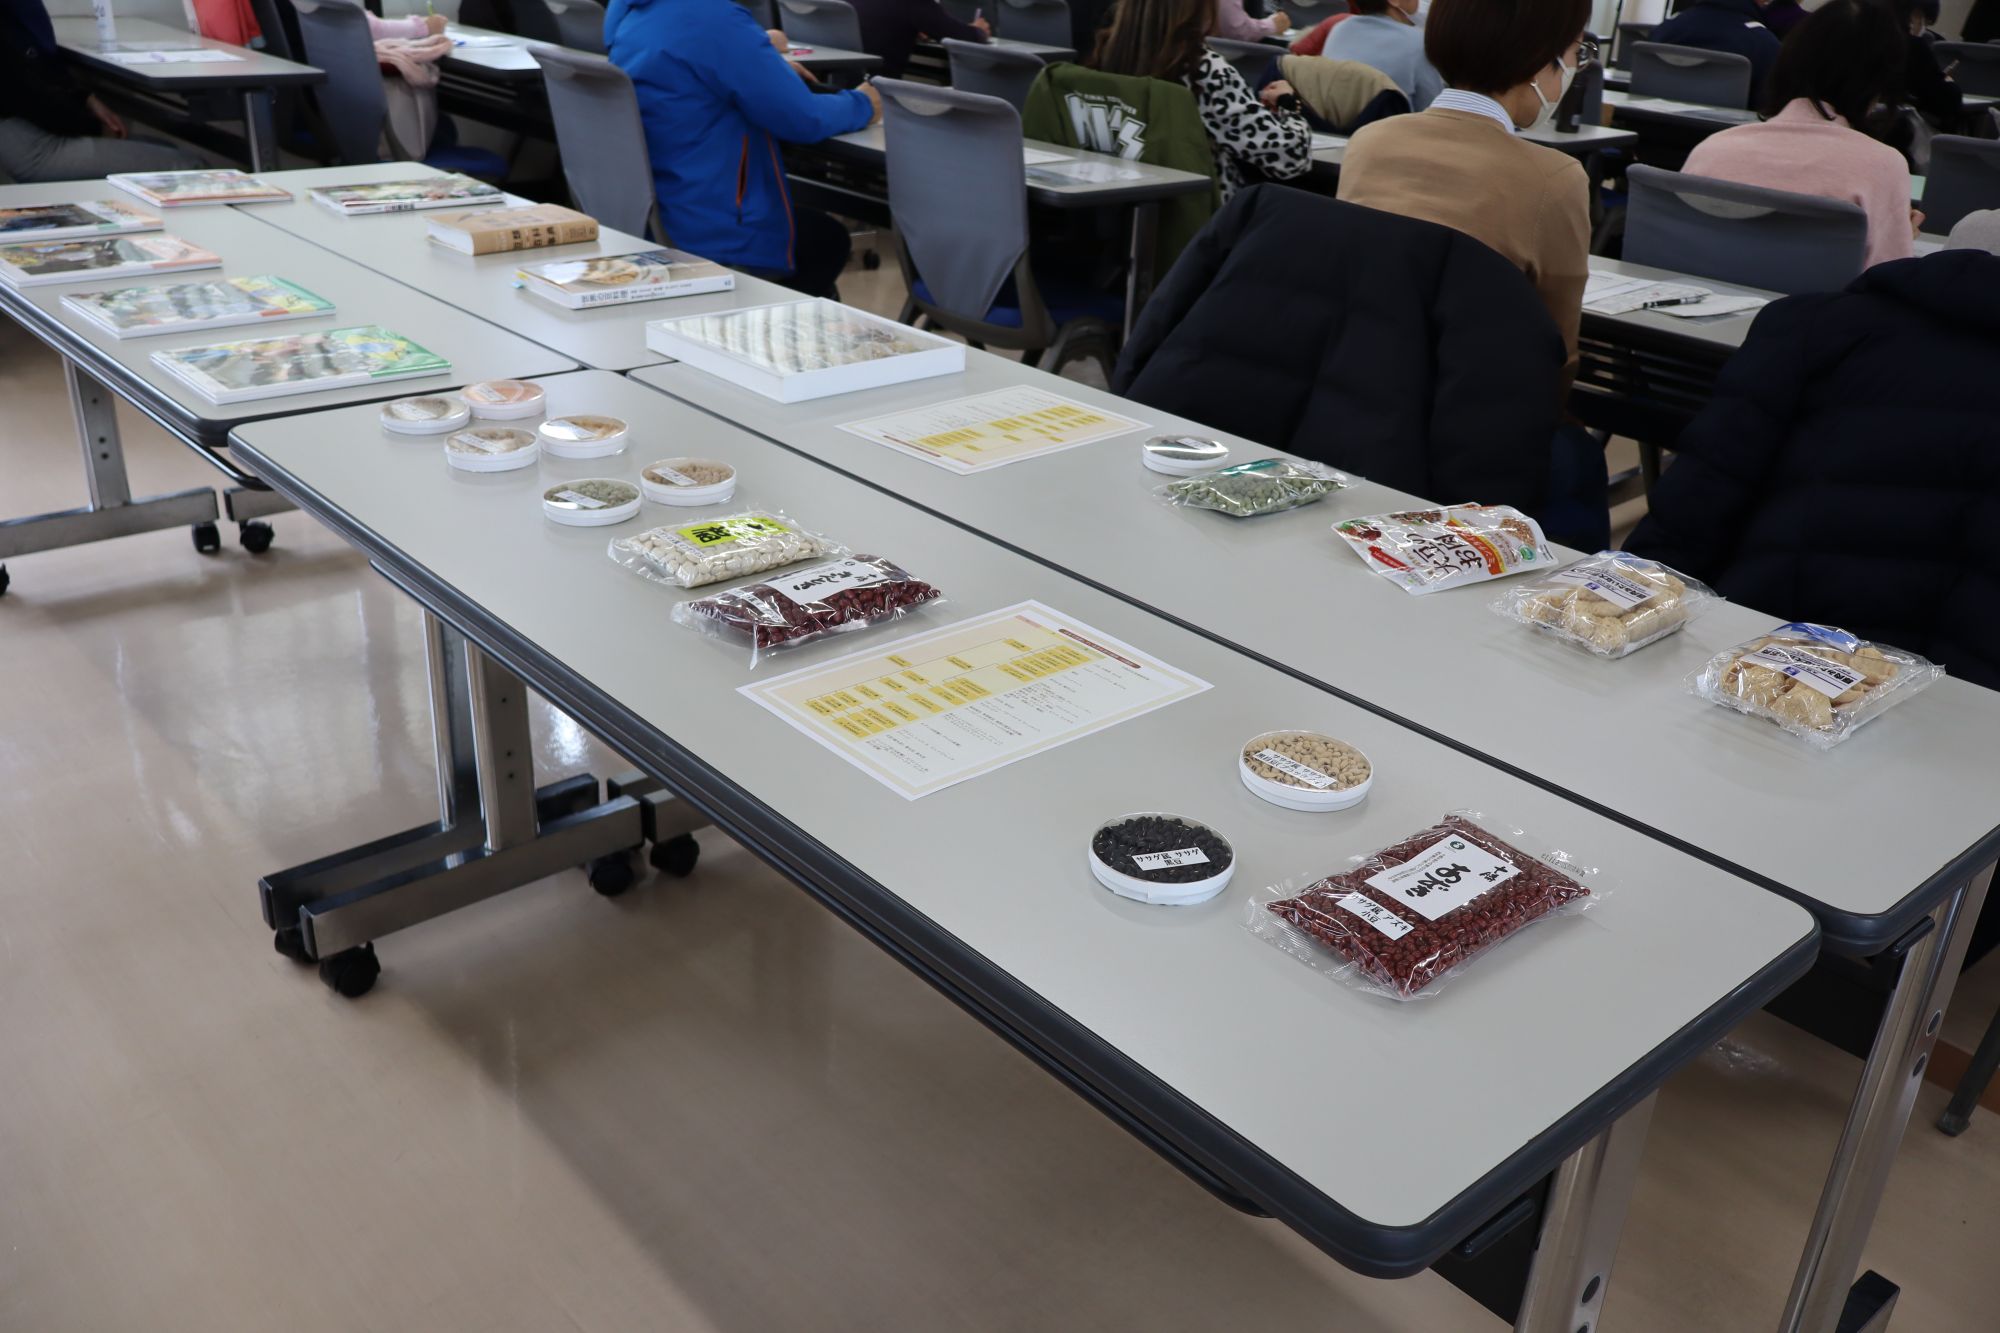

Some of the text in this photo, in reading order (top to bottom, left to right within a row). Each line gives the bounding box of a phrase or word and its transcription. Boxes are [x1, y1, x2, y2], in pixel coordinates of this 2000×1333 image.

[1175, 849, 1199, 857] ササゲ
[1405, 863, 1471, 897] あずき
[1479, 865, 1508, 882] 十勝
[1361, 910, 1382, 925] 小豆
[1386, 914, 1410, 931] アズキ
